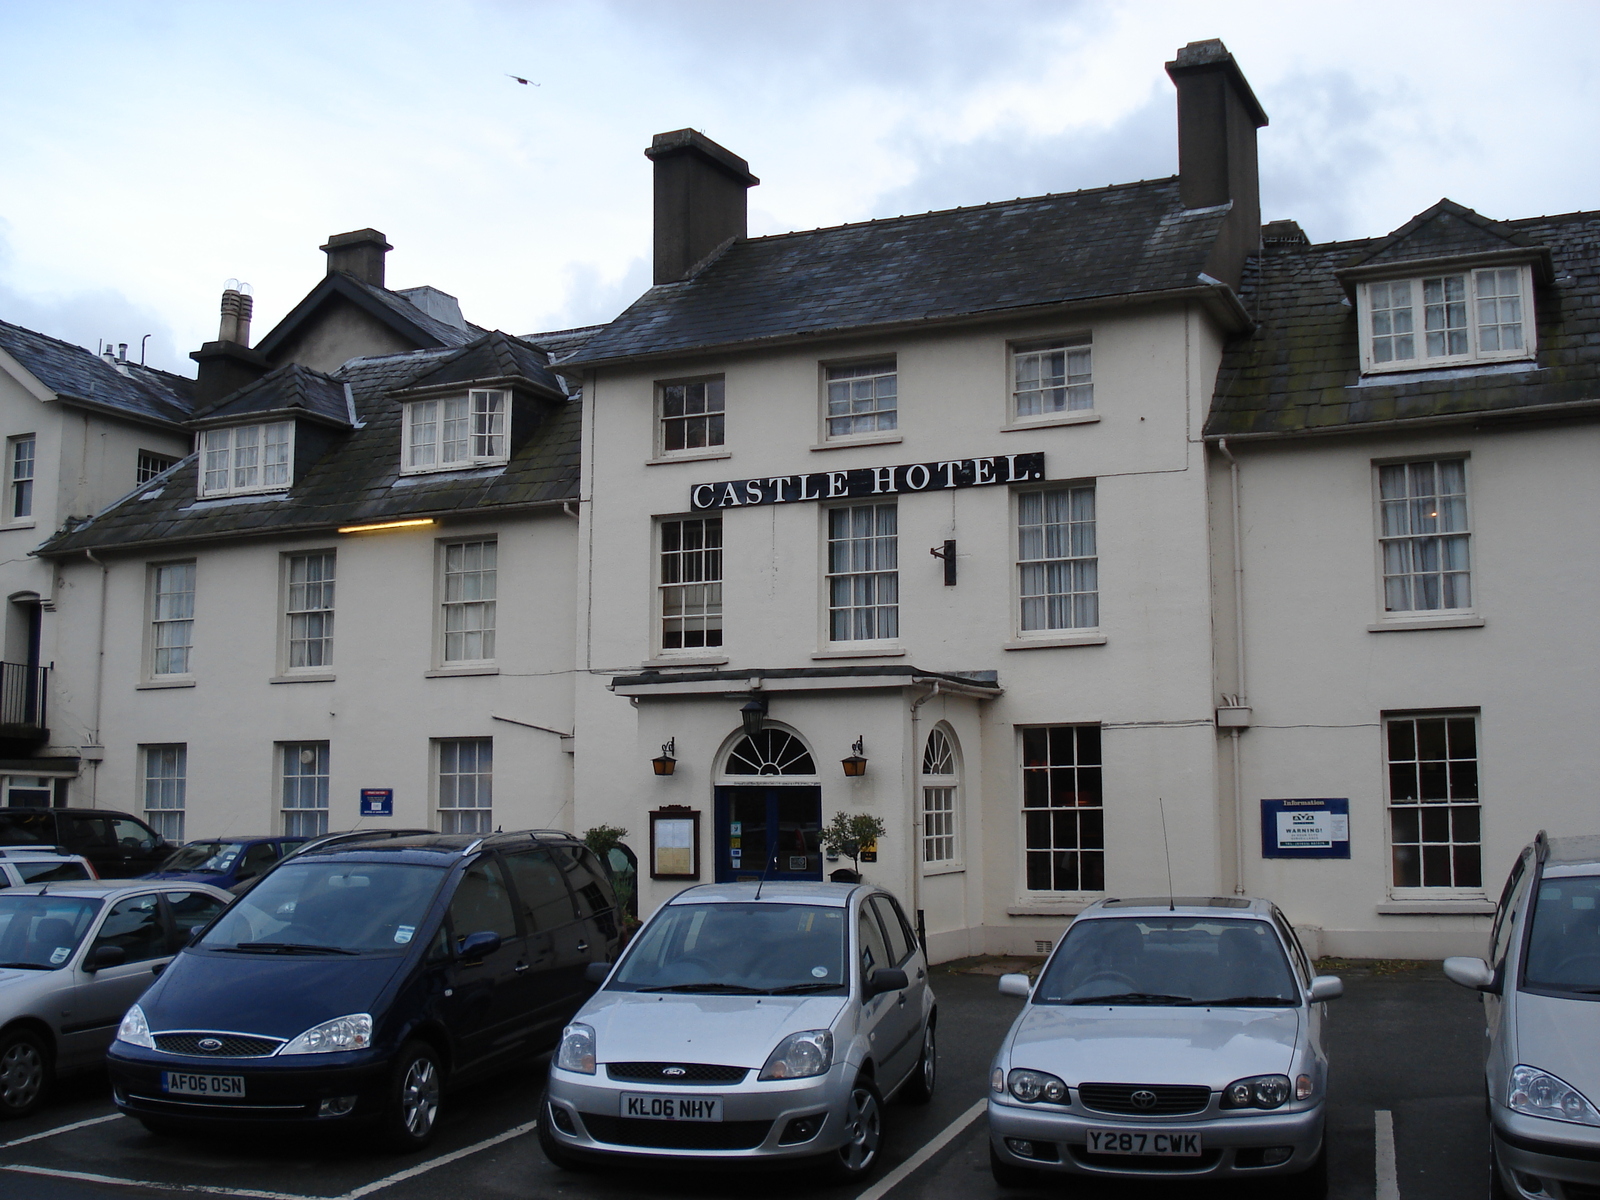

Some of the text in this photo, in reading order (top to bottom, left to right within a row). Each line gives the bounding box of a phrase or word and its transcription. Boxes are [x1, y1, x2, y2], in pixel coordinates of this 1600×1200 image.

[692, 454, 1042, 509] CASTLE HOTEL.
[170, 1074, 242, 1093] AF06 OSN
[628, 1097, 715, 1118] KL06 NHY
[1089, 1132, 1198, 1153] Y287 CWK
